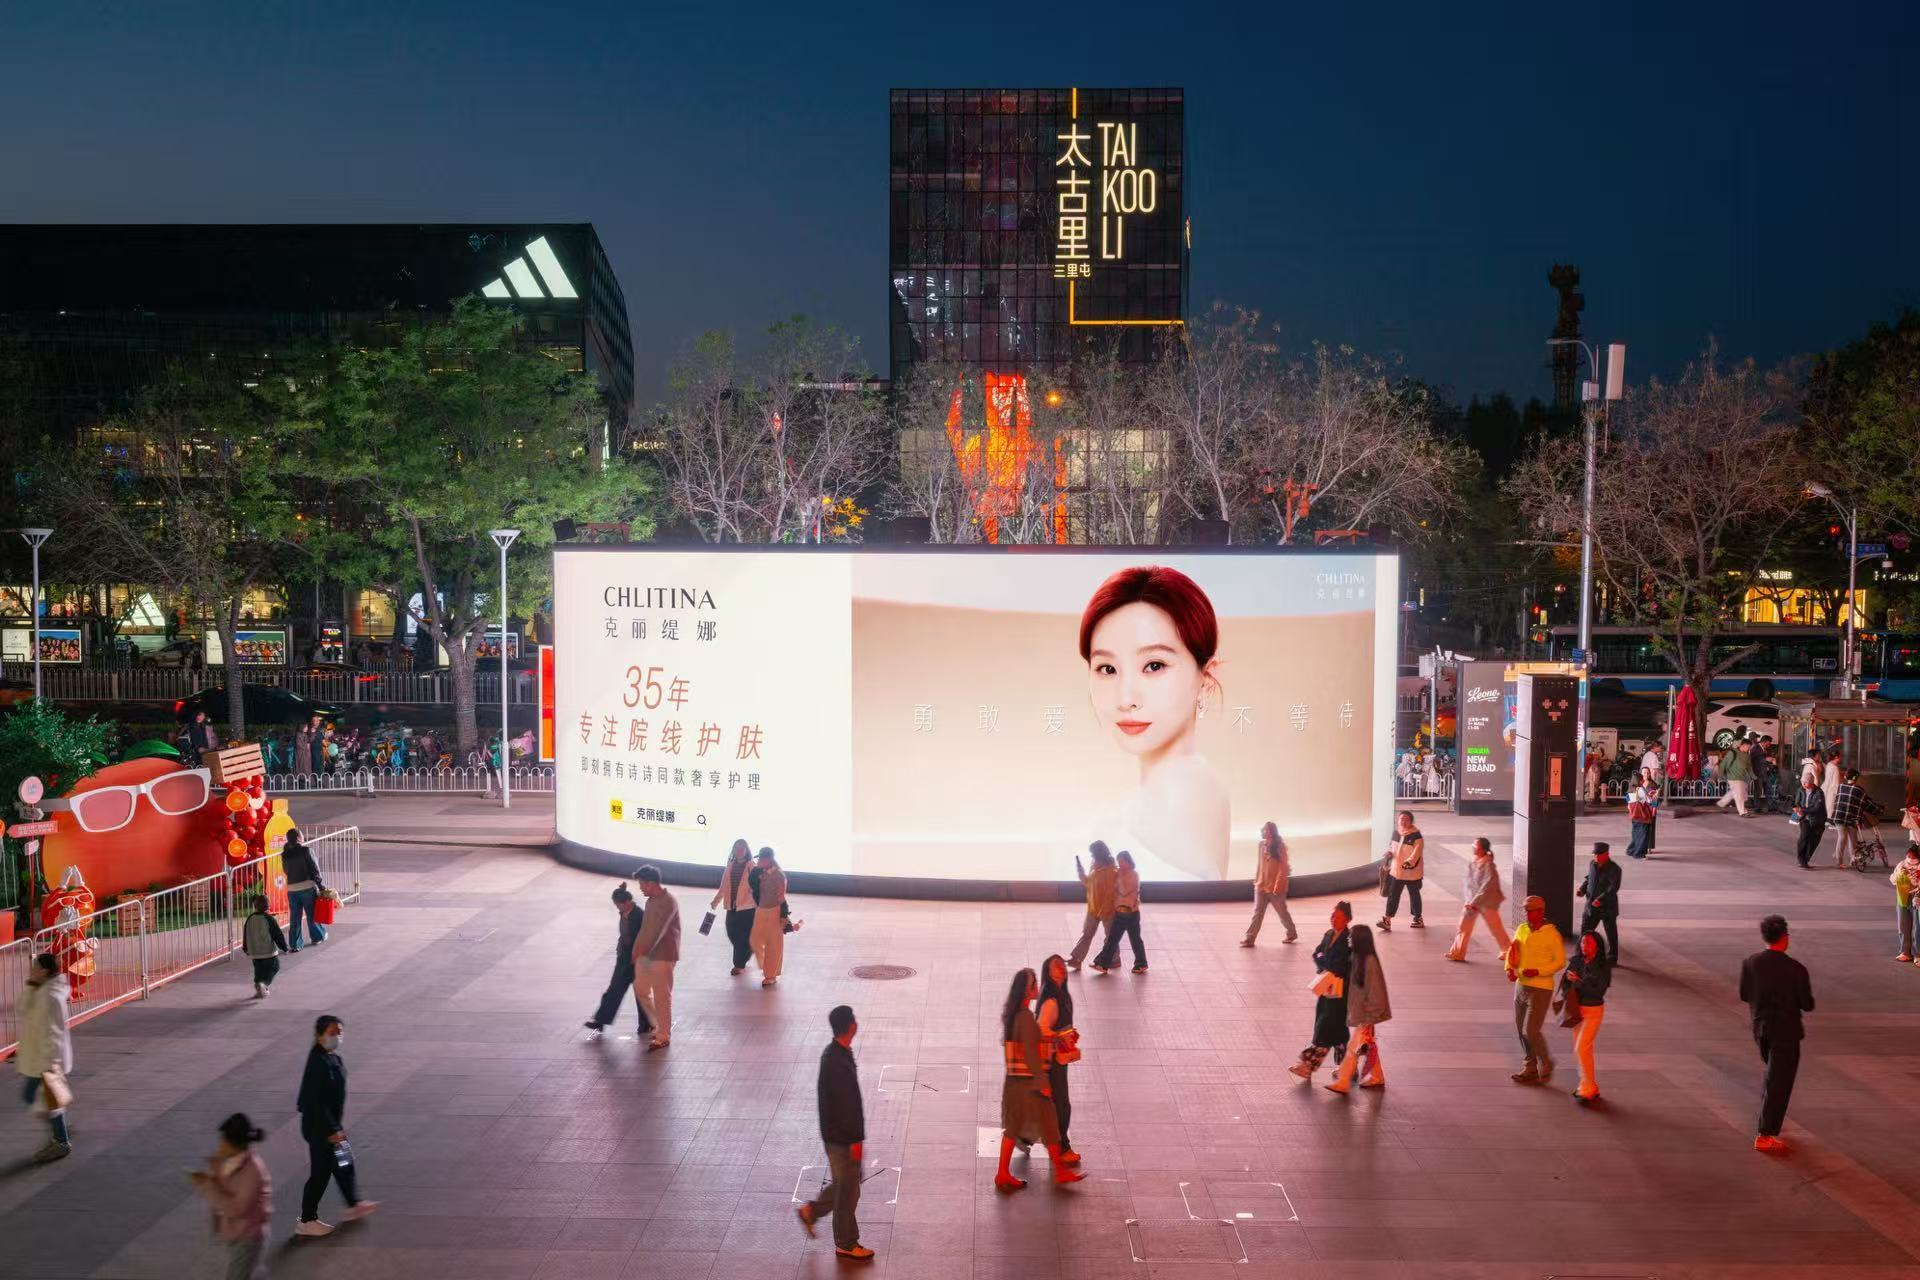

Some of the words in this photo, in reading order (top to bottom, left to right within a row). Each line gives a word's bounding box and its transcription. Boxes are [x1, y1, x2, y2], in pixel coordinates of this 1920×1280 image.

[1097, 122, 1137, 167] TAI
[1055, 123, 1092, 260] 太古里
[1102, 168, 1156, 213] KOO
[1102, 215, 1123, 260] LI
[1053, 262, 1091, 278] 三里屯
[604, 586, 717, 610] CHLITINA
[604, 616, 717, 642] 克丽缇娜
[623, 665, 691, 712] 35年
[579, 710, 764, 761] 专注院线护肤
[912, 703, 1068, 735] 勇敢爱
[1231, 698, 1355, 736] 不等待
[1466, 755, 1487, 764] NEW
[1466, 763, 1497, 773] BRAND
